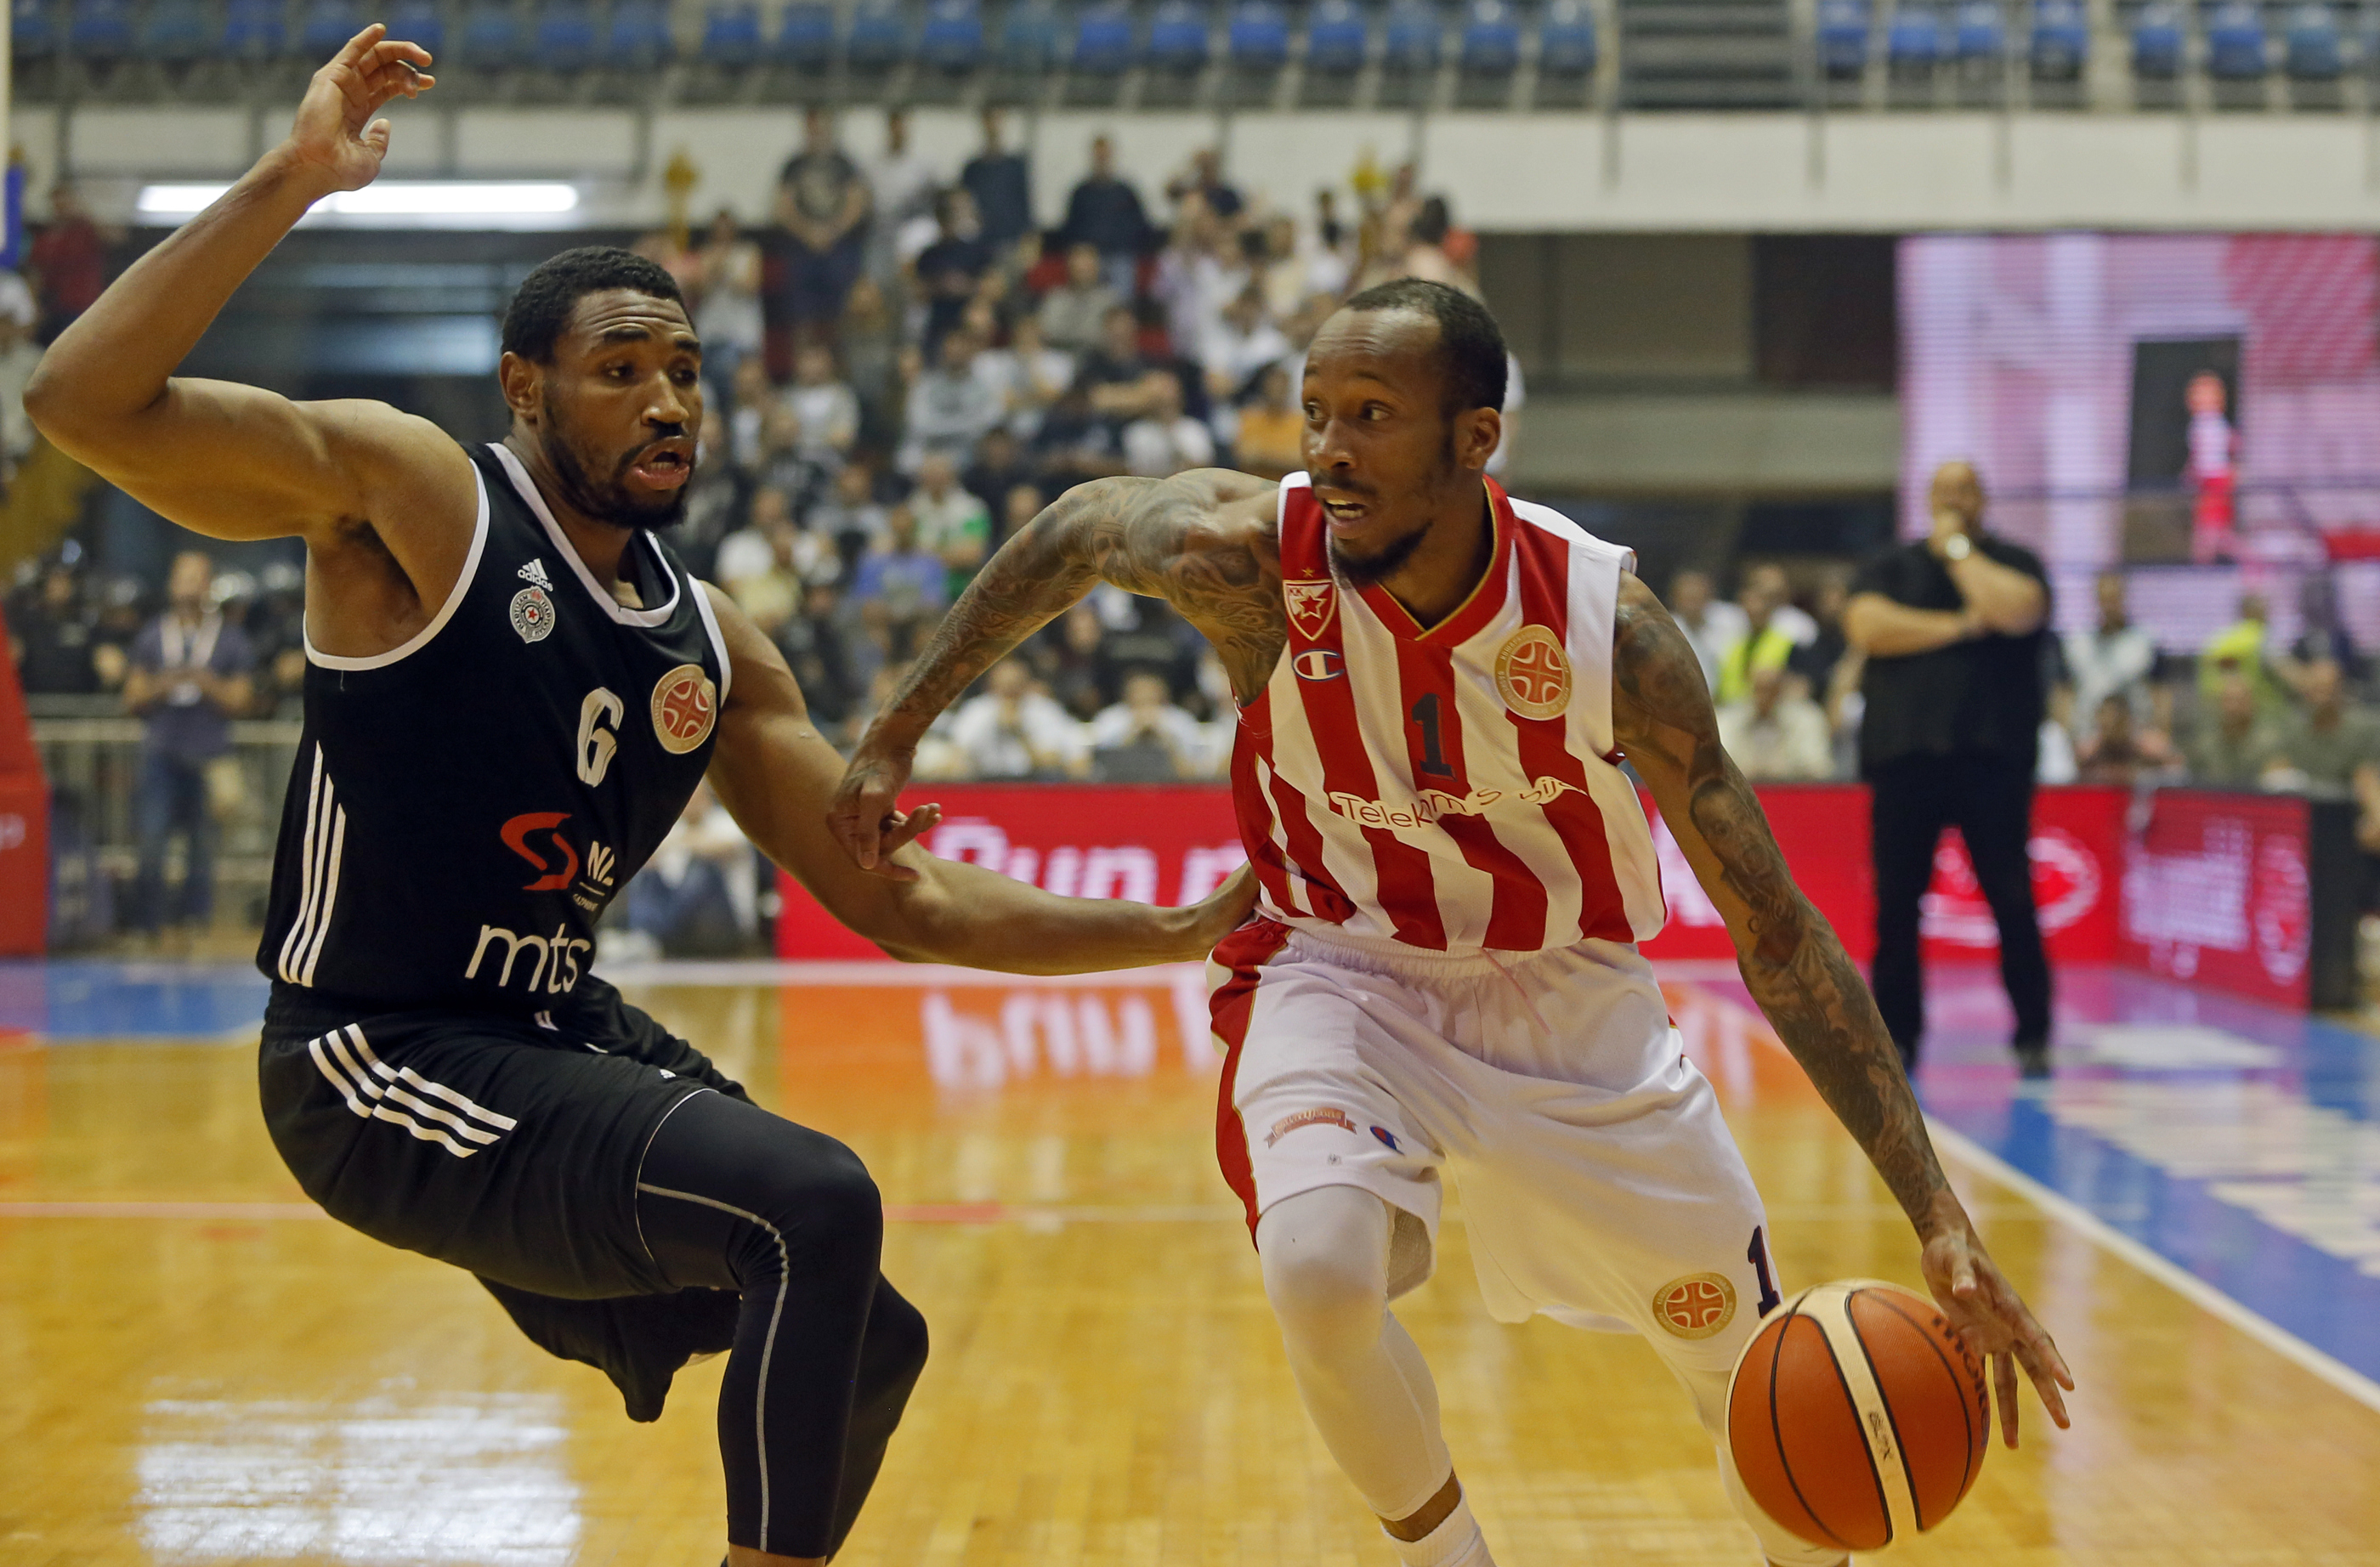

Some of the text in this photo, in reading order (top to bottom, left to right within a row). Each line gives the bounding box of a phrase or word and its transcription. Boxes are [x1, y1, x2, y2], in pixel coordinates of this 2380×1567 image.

[517, 569, 553, 592] adidas
[577, 687, 624, 788] 6
[1411, 692, 1458, 782] 1
[465, 923, 592, 993] mts
[1748, 1225, 1782, 1320] 1
